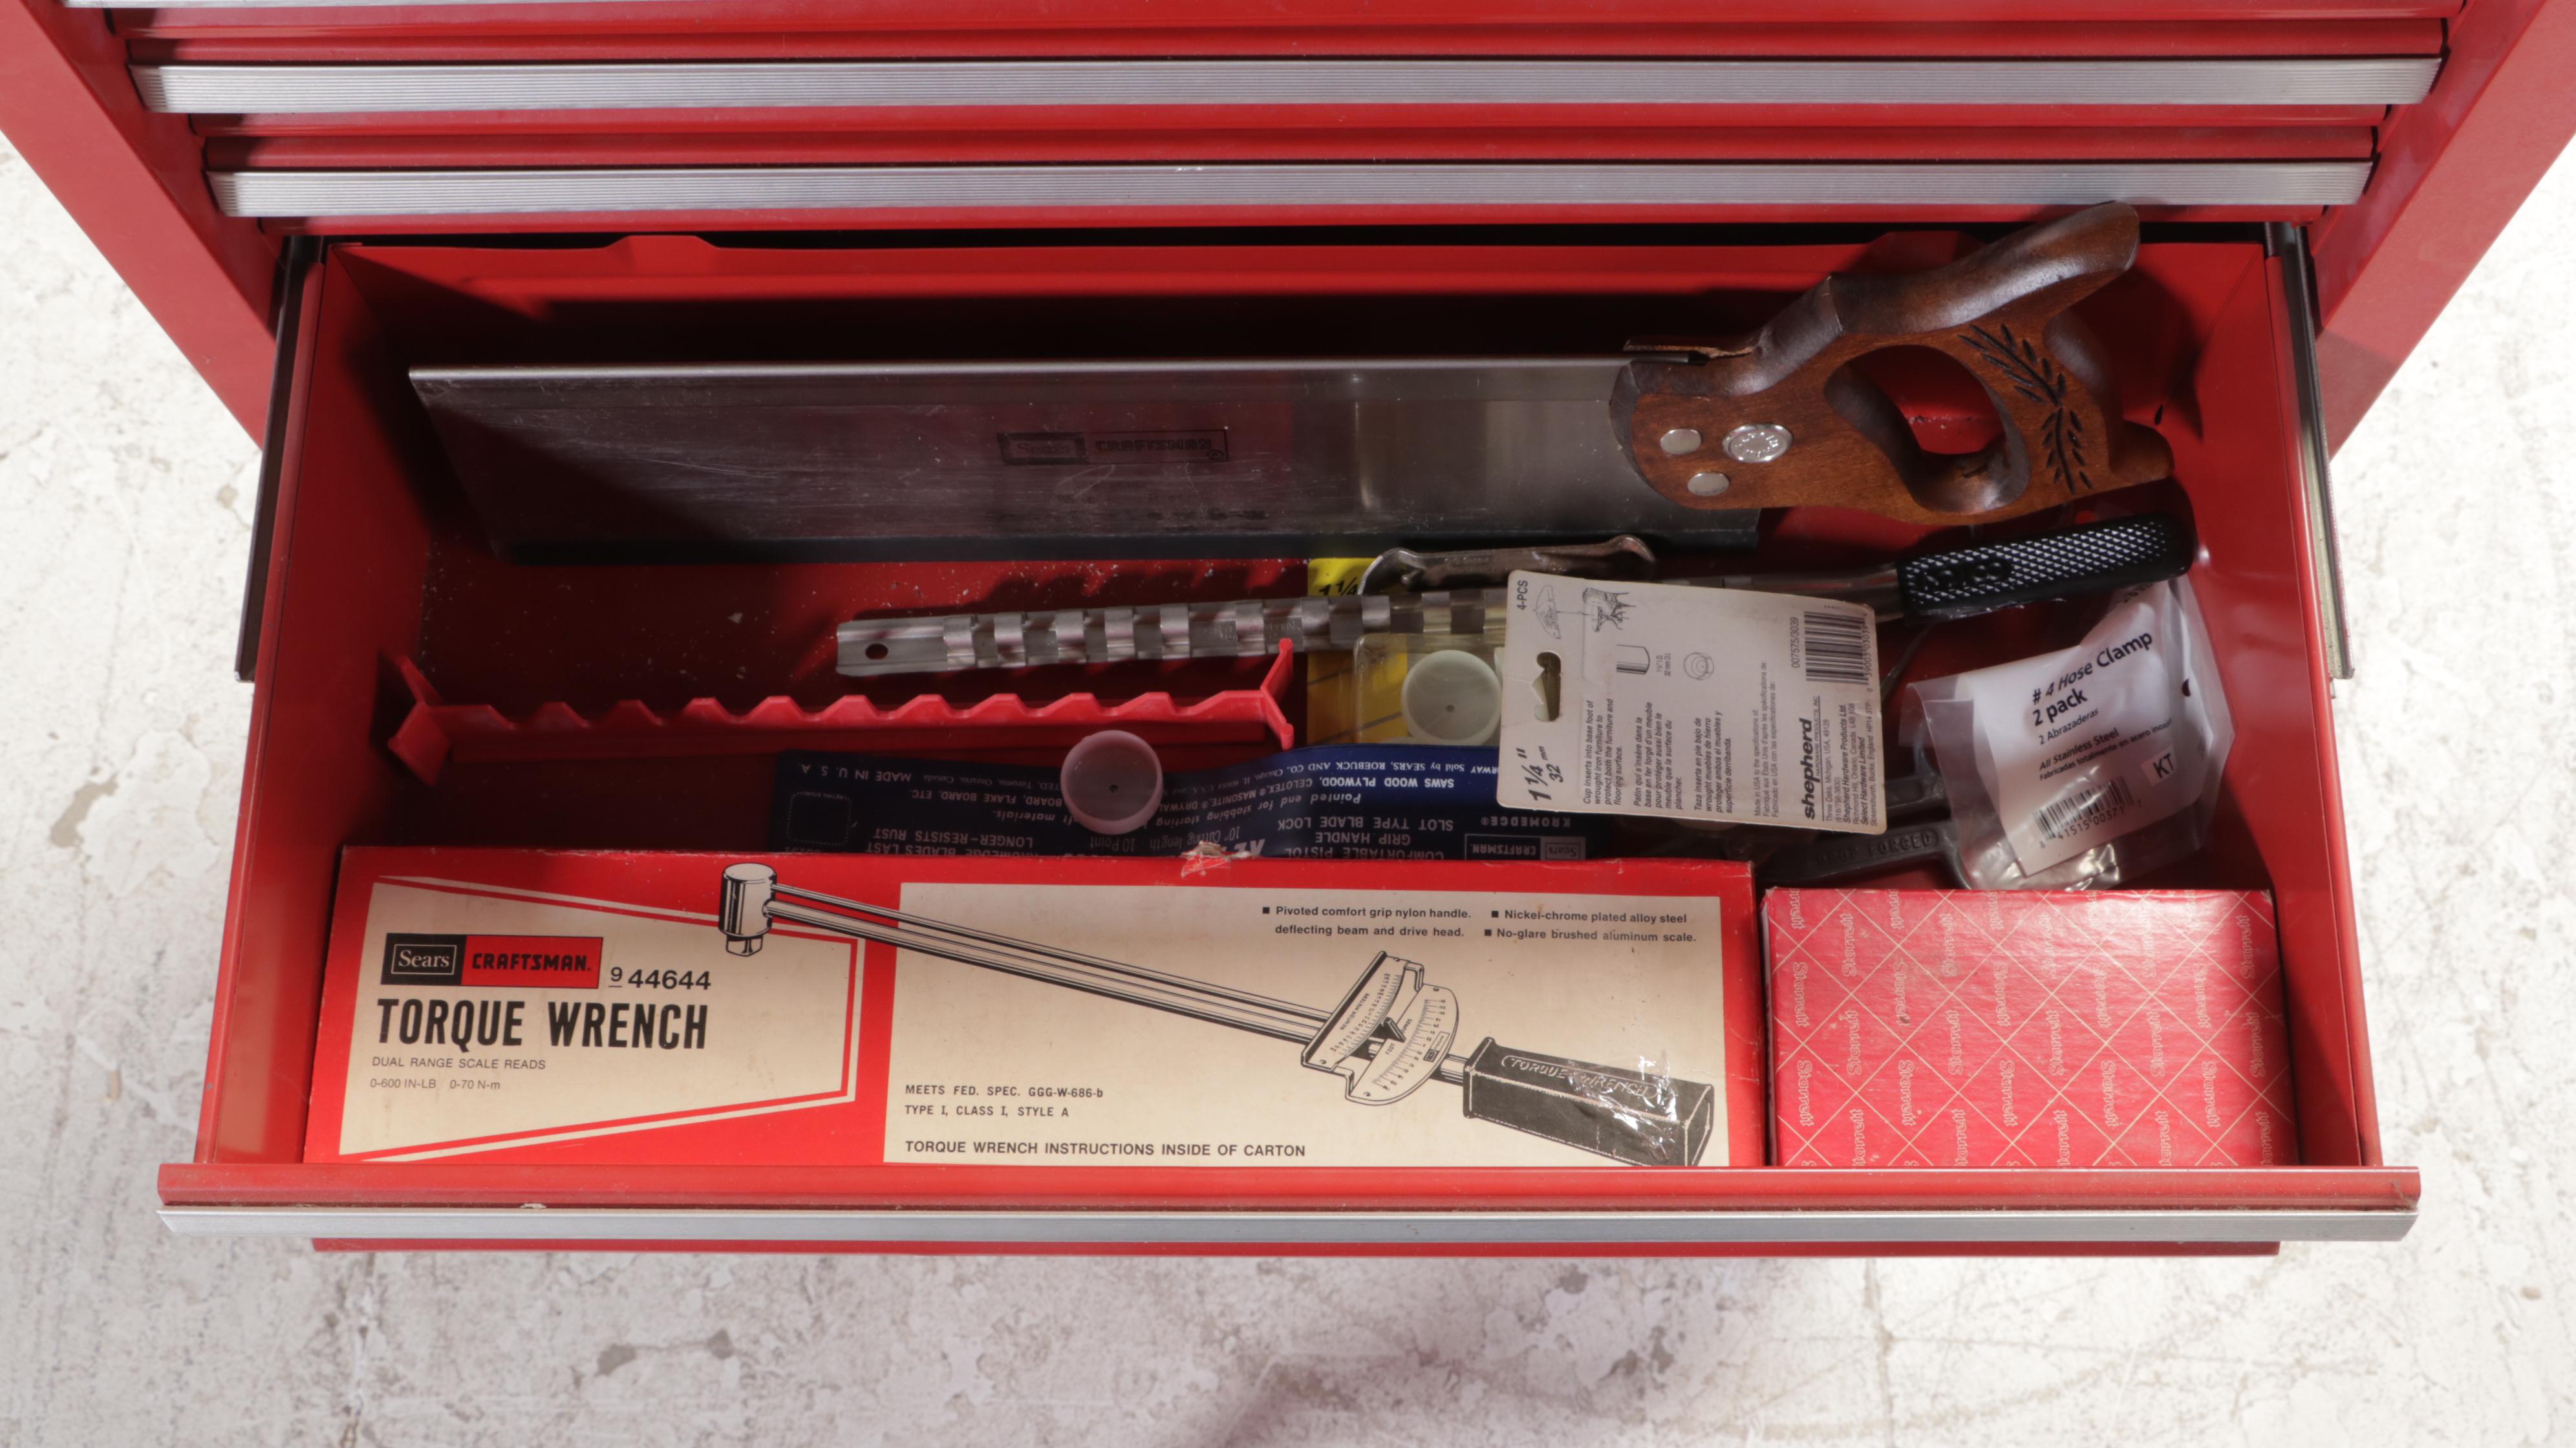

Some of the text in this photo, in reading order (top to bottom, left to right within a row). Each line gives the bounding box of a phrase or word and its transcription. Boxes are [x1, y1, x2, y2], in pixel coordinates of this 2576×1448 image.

[1516, 580, 1528, 610] 4-PCS
[1790, 617, 1800, 668] 007575/3039
[2033, 633, 2152, 705] # 4 Hose Clamp
[2033, 688, 2088, 727] 2 pack
[1605, 714, 1613, 745] furniture
[2039, 708, 2098, 745] 2 Abrazaderas
[1594, 724, 1603, 755] furniture
[1858, 737, 1866, 764] Limited
[2039, 727, 2119, 771] All Stainless Steel
[1308, 762, 1331, 771] AND
[1336, 761, 1386, 770] ROEBUCK
[1391, 761, 1425, 771] SEARS,
[1430, 762, 1441, 771] by
[1538, 746, 1564, 783] 32 mm
[2039, 730, 2151, 781] Fabricadas totalmente acero
[2152, 753, 2173, 778] KT
[855, 769, 869, 780] IN
[875, 771, 912, 782] MADE
[1445, 763, 1465, 772] Sold
[1801, 718, 1821, 820] shepherd
[1320, 777, 1376, 787] PLYWOOD,
[1384, 778, 1418, 787] WOOD
[1424, 778, 1454, 788] SAWS
[1594, 772, 1604, 804] wrought
[1604, 778, 1613, 805] protect
[1613, 776, 1624, 805] flooring
[910, 789, 1064, 807] BOARD, FLAKE BOARD, ETC.
[1583, 788, 1593, 804] Cup
[1842, 787, 1851, 823] Shepherd
[993, 811, 1055, 821] materials.
[1157, 793, 1361, 825] Pointed end for stabbing starting
[1278, 816, 1454, 831] SLOT TYPE BLADE LOCK
[1315, 832, 1410, 846] GRIP HANDLE
[1283, 846, 1444, 860] COMFORTABLE PISTOL
[1276, 906, 1471, 919] Pivoted comfort grip nylon handle.
[1505, 910, 1686, 925] Nickel-chrome plated alloy steel
[1275, 924, 1464, 936] deflecting beam and drive head.
[1497, 928, 1696, 942] No-glare brushed aluminum scale.
[1842, 913, 1856, 977] Starrett
[397, 949, 450, 968] Sears
[628, 969, 711, 990] 44644
[1793, 962, 1808, 1027] Starrett
[1993, 962, 2009, 1027] Starrett
[378, 999, 707, 1053] TORQUE WRENCH
[1847, 1010, 1862, 1075] Starrett
[1949, 1010, 1963, 1074] Starrett
[2049, 1010, 2064, 1076] Starrett
[2251, 1012, 2266, 1077] Starrett
[372, 1056, 546, 1070] DUAL RANGE SCALE READS
[370, 1078, 500, 1089] 0-600 IN-LB 0-70 N-m
[905, 1085, 1103, 1098] MEETS FED. SPEC. GGG-W-686-b
[1798, 1060, 1812, 1125] Starrett
[905, 1105, 934, 1114] TYPE
[956, 1105, 993, 1116] CLASS
[1018, 1107, 1054, 1116] STYLE
[1061, 1107, 1069, 1117] A
[905, 1141, 1305, 1156] TORQUE WRENCH INSTRUCTIONS INSIDE OF CARTON
